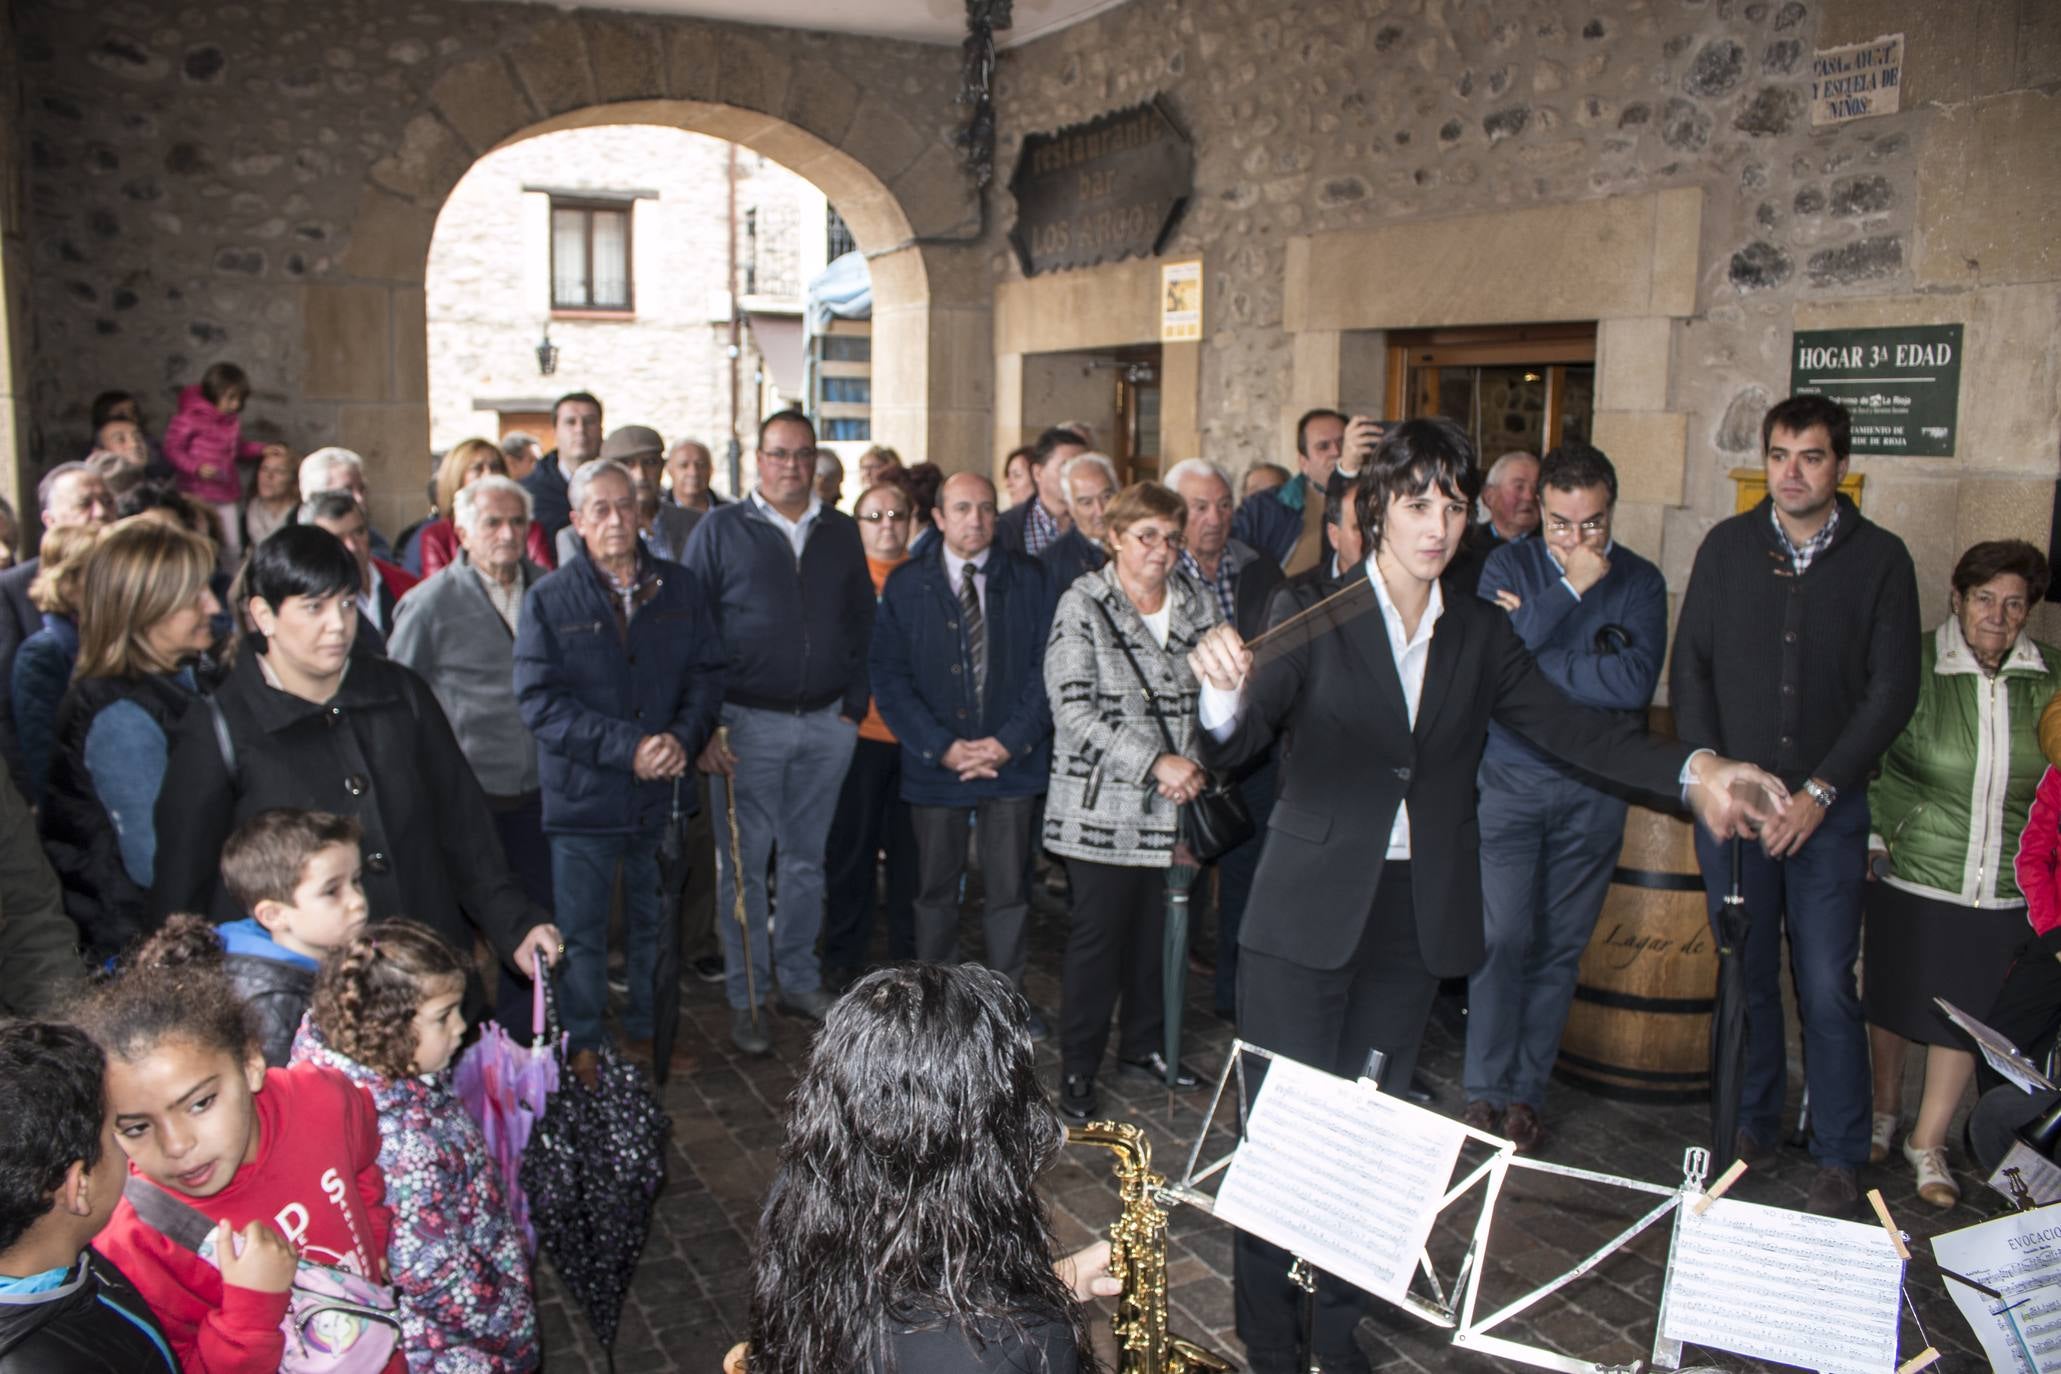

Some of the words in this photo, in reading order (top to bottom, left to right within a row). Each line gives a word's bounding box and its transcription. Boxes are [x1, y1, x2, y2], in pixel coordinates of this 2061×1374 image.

[1813, 82, 1818, 100] Y
[1824, 73, 1876, 97] ESCUELA
[1881, 66, 1898, 88] DE
[1799, 345, 1864, 370] HOGAR
[1896, 343, 1952, 367] EDAD
[1883, 436, 1907, 446] RIOJA
[1601, 922, 1675, 970] Lagar
[1681, 921, 1711, 955] de
